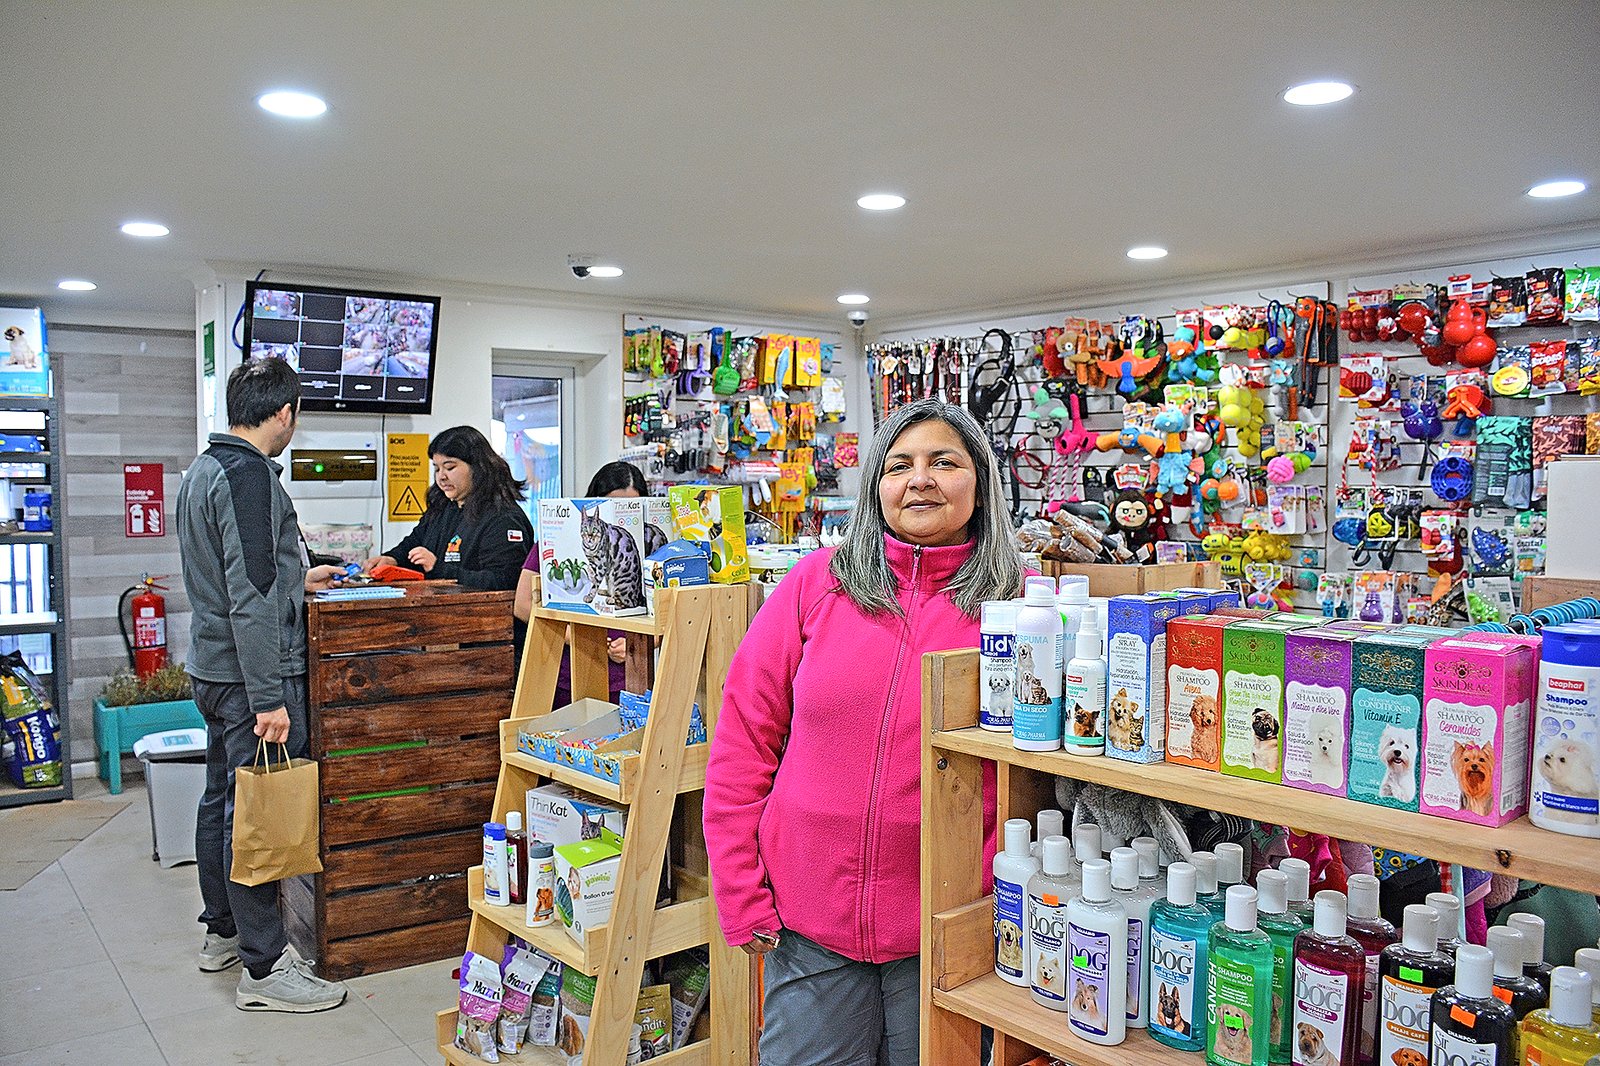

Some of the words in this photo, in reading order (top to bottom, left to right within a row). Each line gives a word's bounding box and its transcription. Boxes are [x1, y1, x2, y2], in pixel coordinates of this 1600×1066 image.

[542, 504, 570, 518] ThinKat
[614, 502, 641, 510] ThinKat
[649, 500, 671, 509] ThinKa
[1517, 539, 1543, 548] dental
[1176, 675, 1211, 686] SHAMPOO
[1234, 681, 1272, 692] SHAMPOO
[1550, 680, 1583, 689] beaphar
[1296, 693, 1336, 705] SHAMPOO
[1546, 694, 1588, 706] Shampoo
[1291, 701, 1310, 711] Matico
[1315, 705, 1328, 714] Aloe
[1328, 706, 1340, 715] Vera
[1358, 700, 1412, 714] CONDITIONER
[1364, 709, 1393, 723] Vitamin
[1396, 713, 1402, 724] E
[1437, 711, 1485, 724] SHAMPOO
[1440, 720, 1481, 736] Ceramides
[531, 797, 568, 818] ThinKat
[998, 888, 1022, 900] SHAMPOO
[1029, 912, 1066, 939] DOG
[1152, 933, 1162, 948] Sir
[1160, 931, 1182, 941] SHAMPOO
[1070, 942, 1108, 971] DOG
[1152, 945, 1194, 975] DOG
[1217, 966, 1253, 982] SHAMPOO
[1297, 966, 1308, 981] Sir
[1306, 964, 1331, 975] SHAMPOO
[1176, 975, 1188, 983] PELO
[1208, 960, 1217, 1025] CANISH
[1296, 979, 1343, 1012] DOG
[1384, 984, 1398, 1001] Sir
[1395, 983, 1423, 994] SHAMPOO
[1383, 998, 1429, 1031] DOG
[1390, 1025, 1409, 1036] PELAJE
[1447, 1029, 1477, 1044] SHAMPOO
[1435, 1030, 1449, 1050] Sir
[1434, 1044, 1489, 1066] DO
